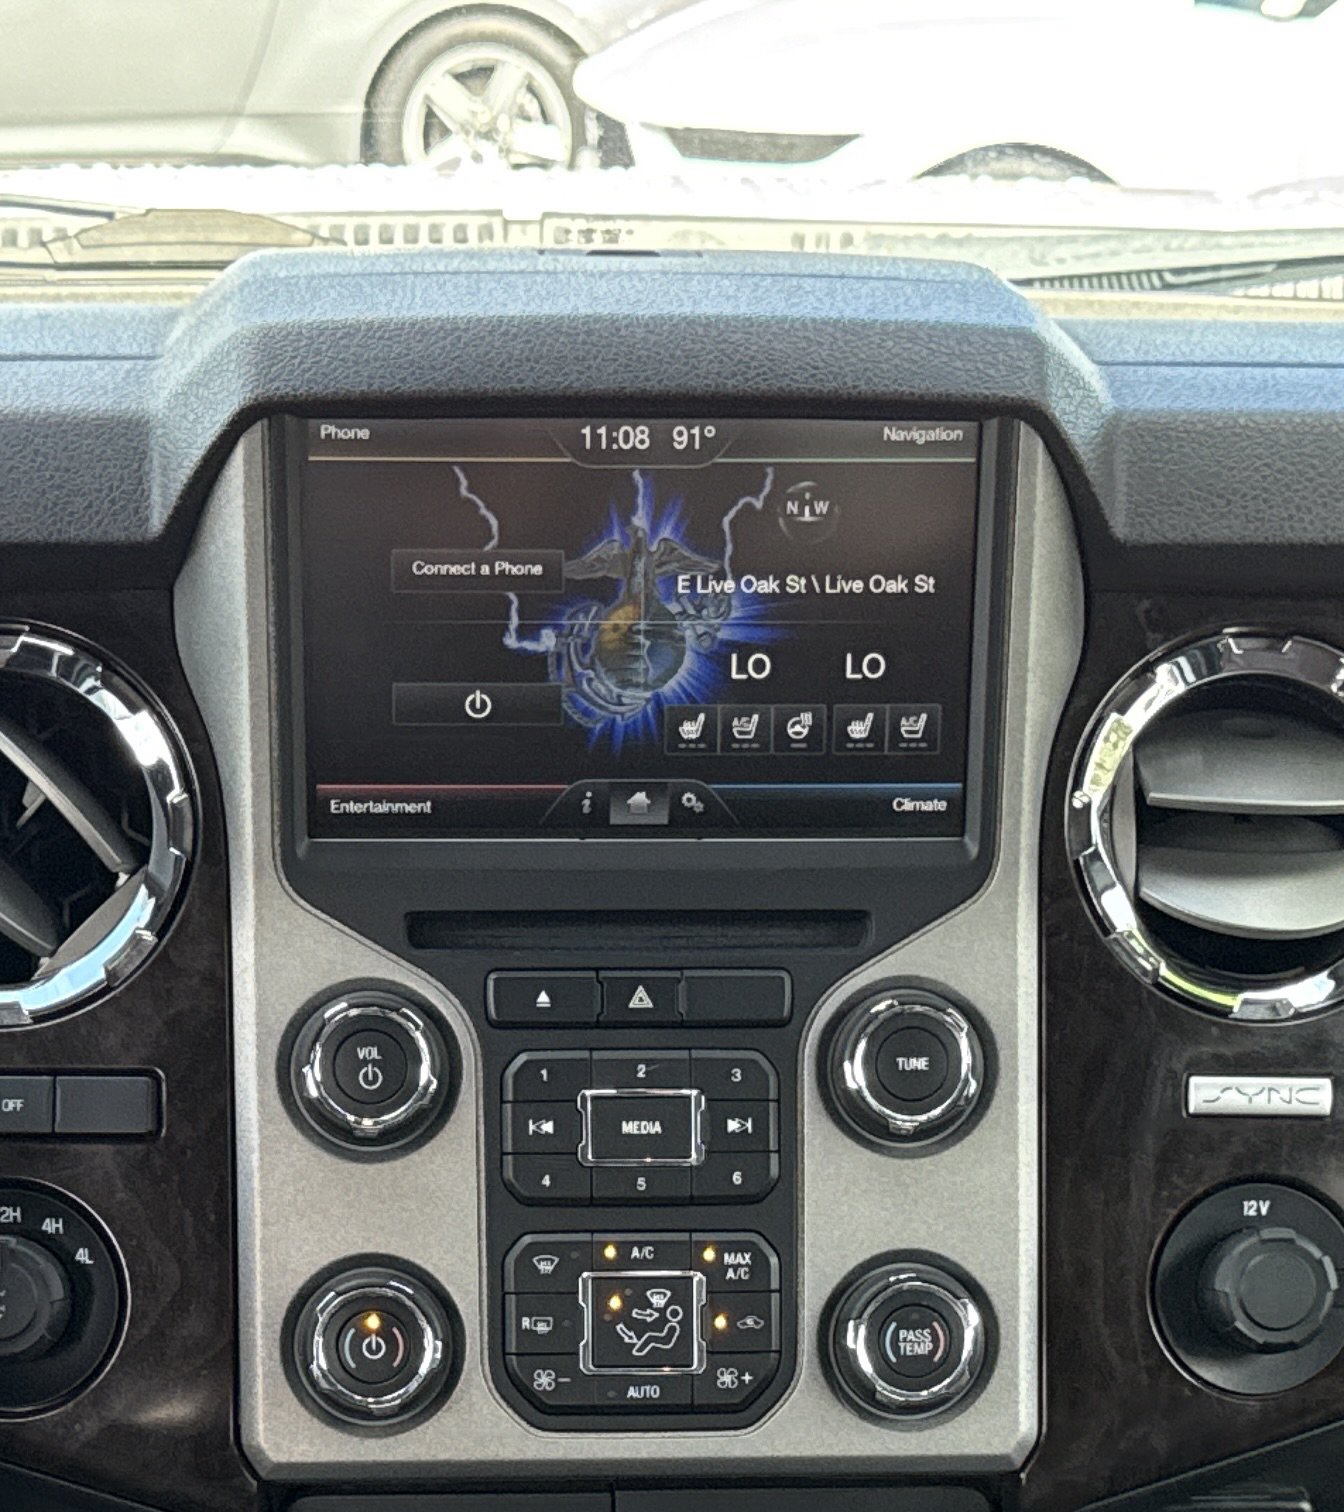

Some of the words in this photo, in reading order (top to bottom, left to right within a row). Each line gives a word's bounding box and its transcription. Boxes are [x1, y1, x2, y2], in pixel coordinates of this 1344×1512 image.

[320, 425, 371, 442] Phone
[580, 427, 651, 449] 11:08
[672, 427, 716, 449] 91°
[883, 426, 963, 445] Navigation
[786, 501, 798, 514] N
[813, 501, 830, 514] W
[412, 560, 474, 577] Connect
[480, 564, 490, 577] a
[495, 560, 543, 577] Phone
[677, 575, 690, 593] E
[697, 575, 735, 593] Live
[740, 575, 780, 593] Oak
[785, 575, 806, 593] St
[825, 575, 864, 593] Live
[869, 575, 908, 593] Oak
[913, 575, 935, 593] St
[731, 653, 771, 680] LO
[845, 653, 886, 680] LO
[330, 798, 432, 817] Entertainment
[892, 797, 947, 813] Climate
[357, 1047, 382, 1060] VOL
[637, 1064, 646, 1078] 2
[896, 1057, 930, 1071] TUNE
[540, 1069, 548, 1082] 1
[731, 1068, 742, 1082] 3
[1202, 1087, 1321, 1105] SYNC
[2, 1098, 24, 1112] OFF
[622, 1121, 662, 1134] MEDIA
[541, 1174, 551, 1187] 4
[636, 1178, 646, 1190] 5
[732, 1172, 742, 1185] 6
[0, 1206, 21, 1223] 2H
[1242, 1200, 1271, 1216] 12V
[41, 1218, 63, 1234] 4H
[75, 1248, 94, 1264] 4L
[631, 1246, 654, 1260] A/C
[723, 1252, 752, 1266] MAX
[725, 1267, 750, 1281] A/C
[899, 1329, 932, 1342] PASS
[898, 1343, 933, 1356] TEMP
[627, 1386, 660, 1399] AUTO
